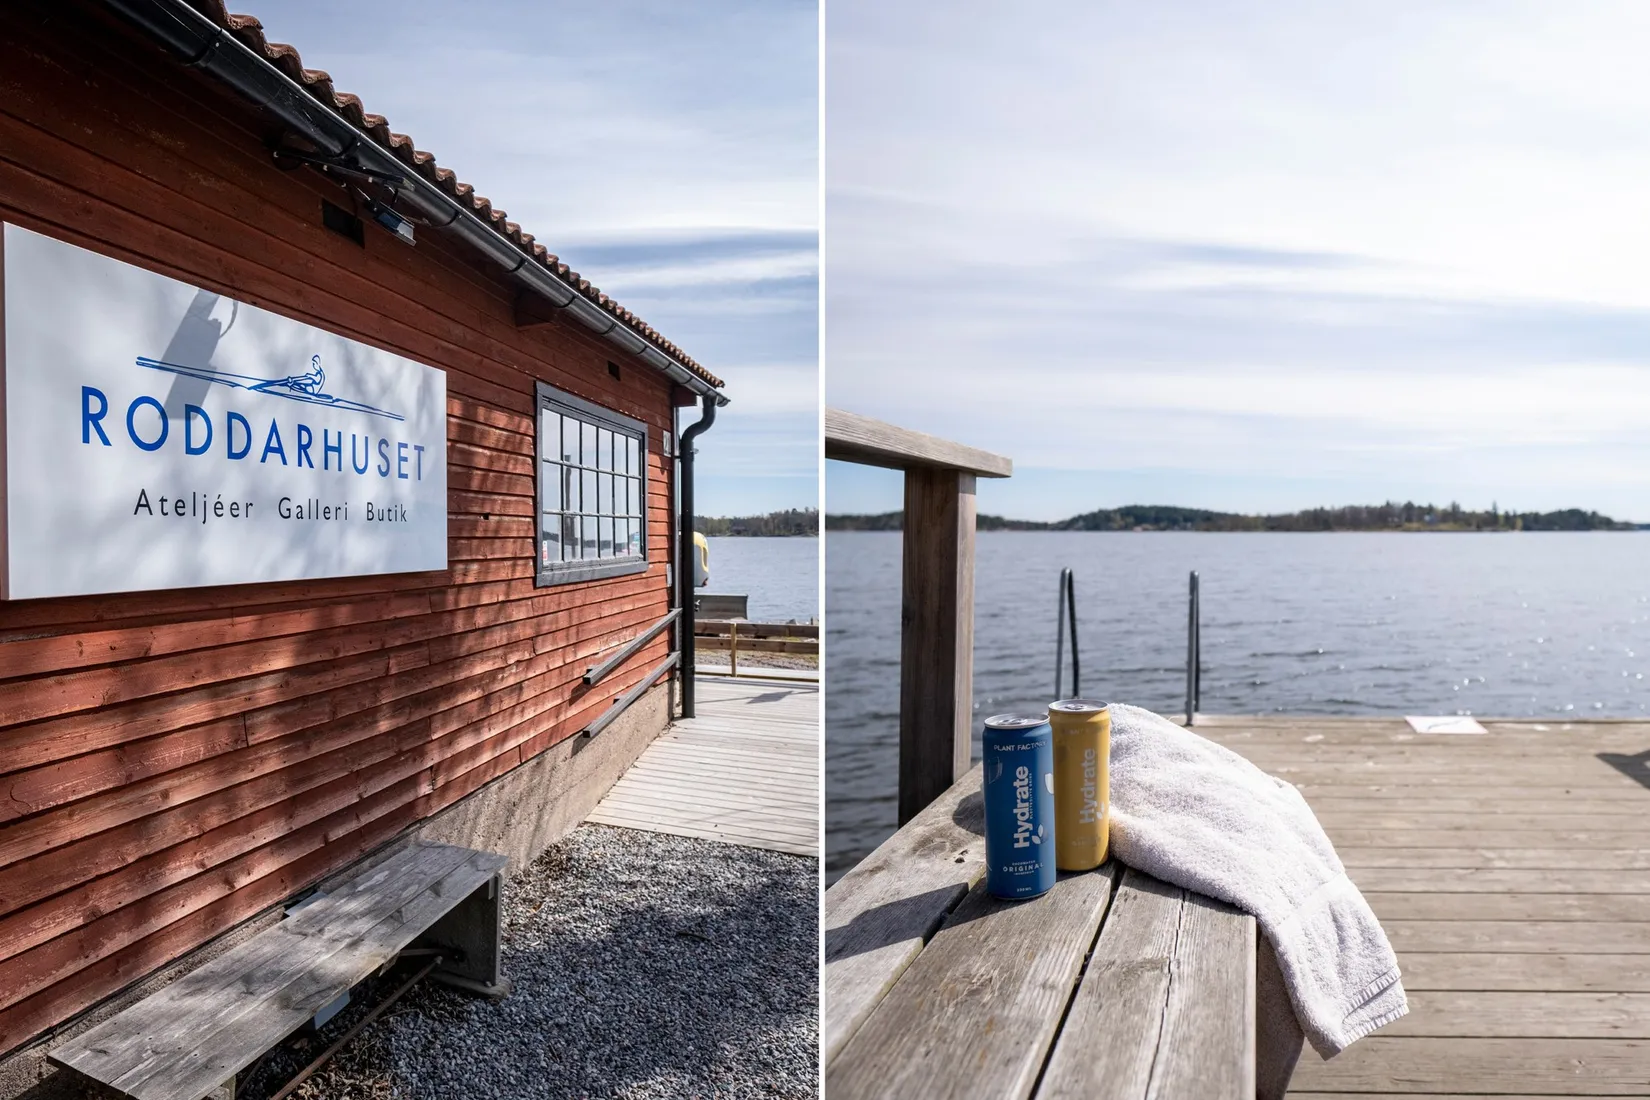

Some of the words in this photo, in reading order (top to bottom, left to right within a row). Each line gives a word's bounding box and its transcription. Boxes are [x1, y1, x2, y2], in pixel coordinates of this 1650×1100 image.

[81, 385, 426, 481] RODDARHUSET
[134, 488, 254, 525] Ateljéer
[278, 496, 348, 521] Galleri
[366, 502, 407, 522] Butik
[993, 744, 1015, 752] PLANT
[1013, 765, 1033, 849] Hydrate
[1079, 748, 1098, 824] Hydrate
[1002, 862, 1044, 873] ORIGINAL
